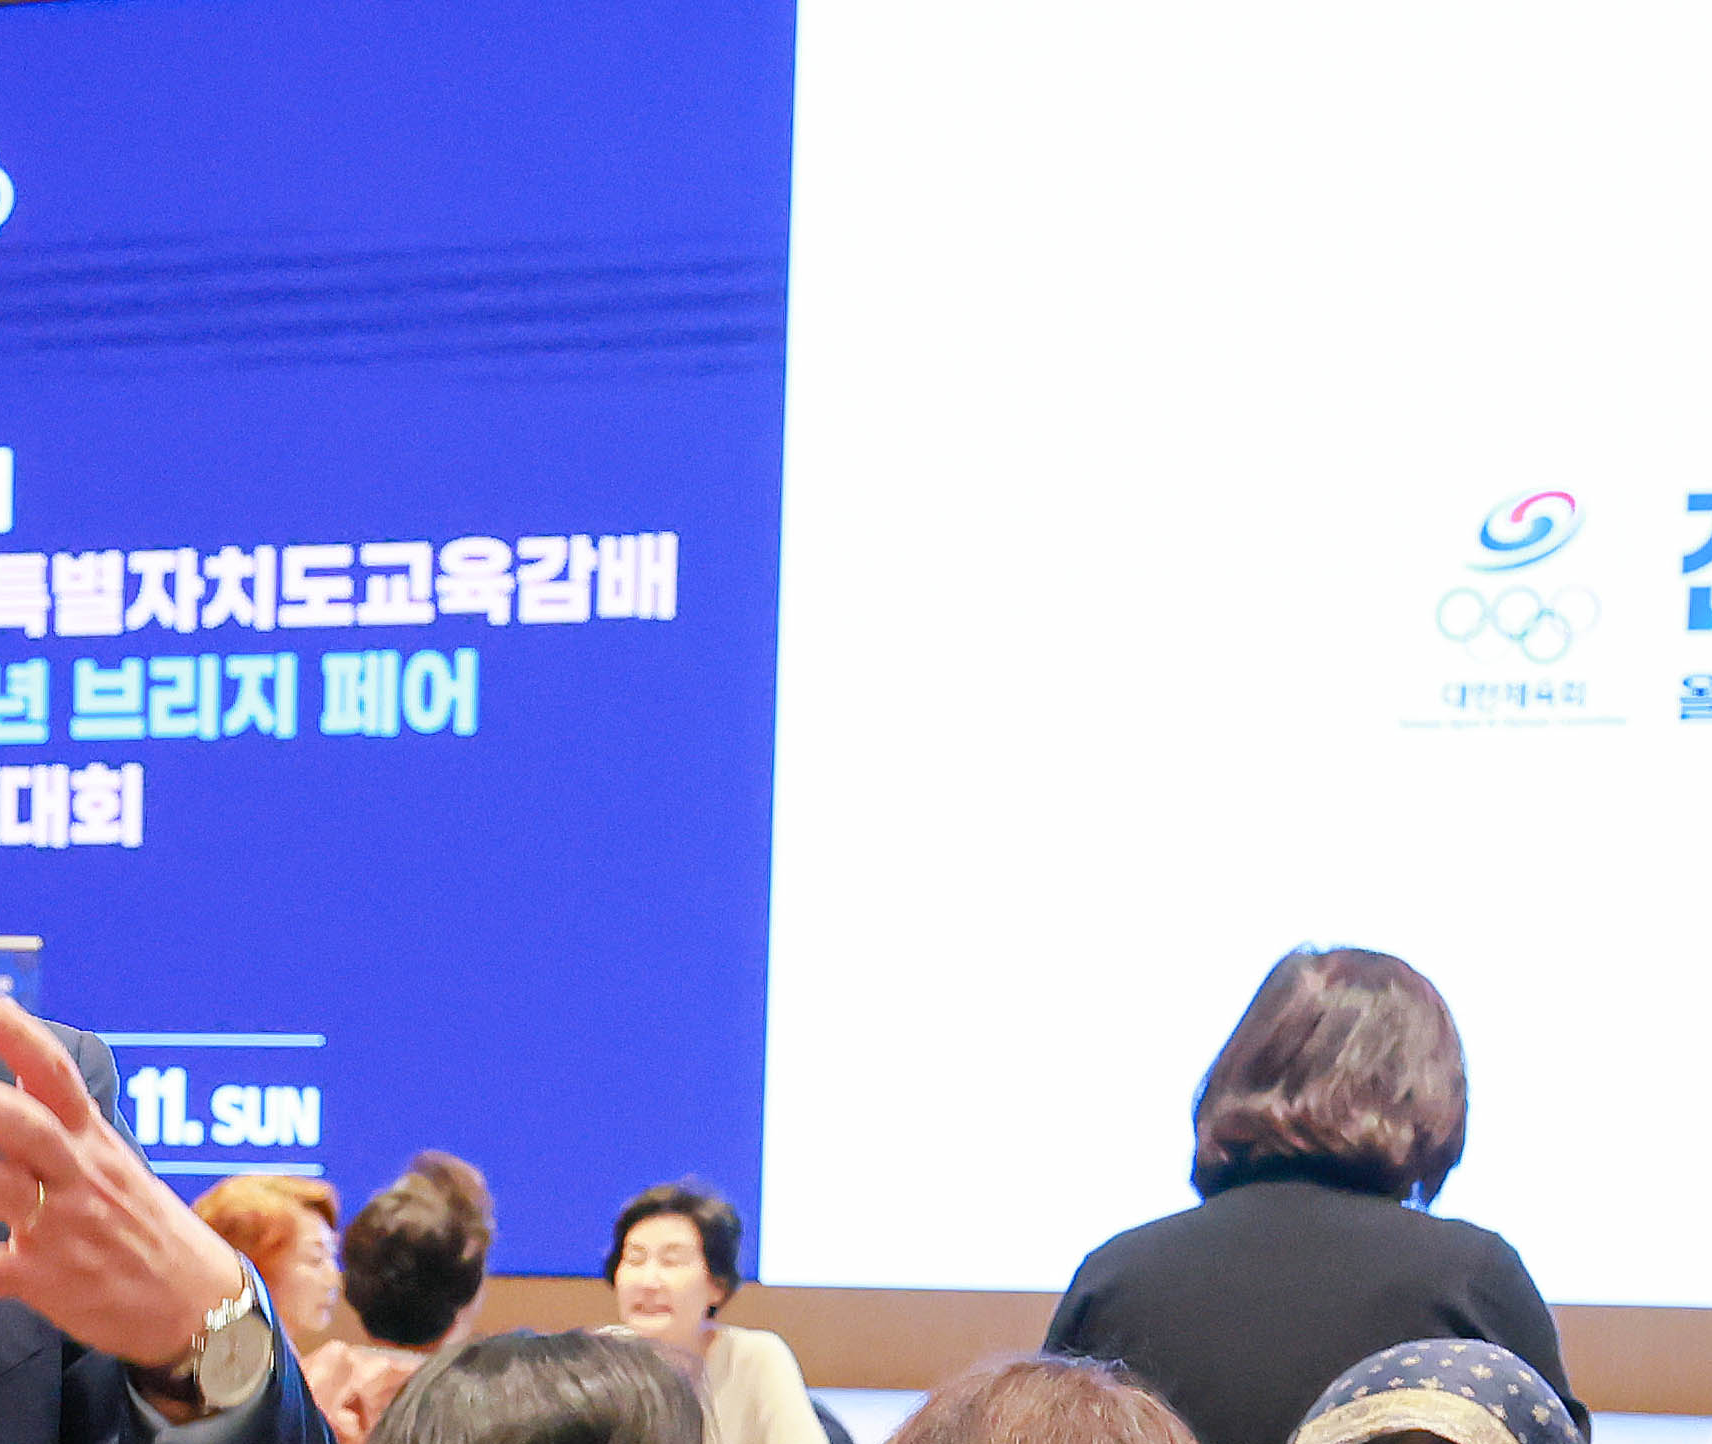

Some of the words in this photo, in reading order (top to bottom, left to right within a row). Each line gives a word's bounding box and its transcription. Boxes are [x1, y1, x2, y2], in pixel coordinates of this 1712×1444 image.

[70, 652, 297, 743] 브리지
[320, 646, 478, 738] 페어
[126, 1066, 205, 1147] 11.
[210, 1085, 321, 1147] SUN
